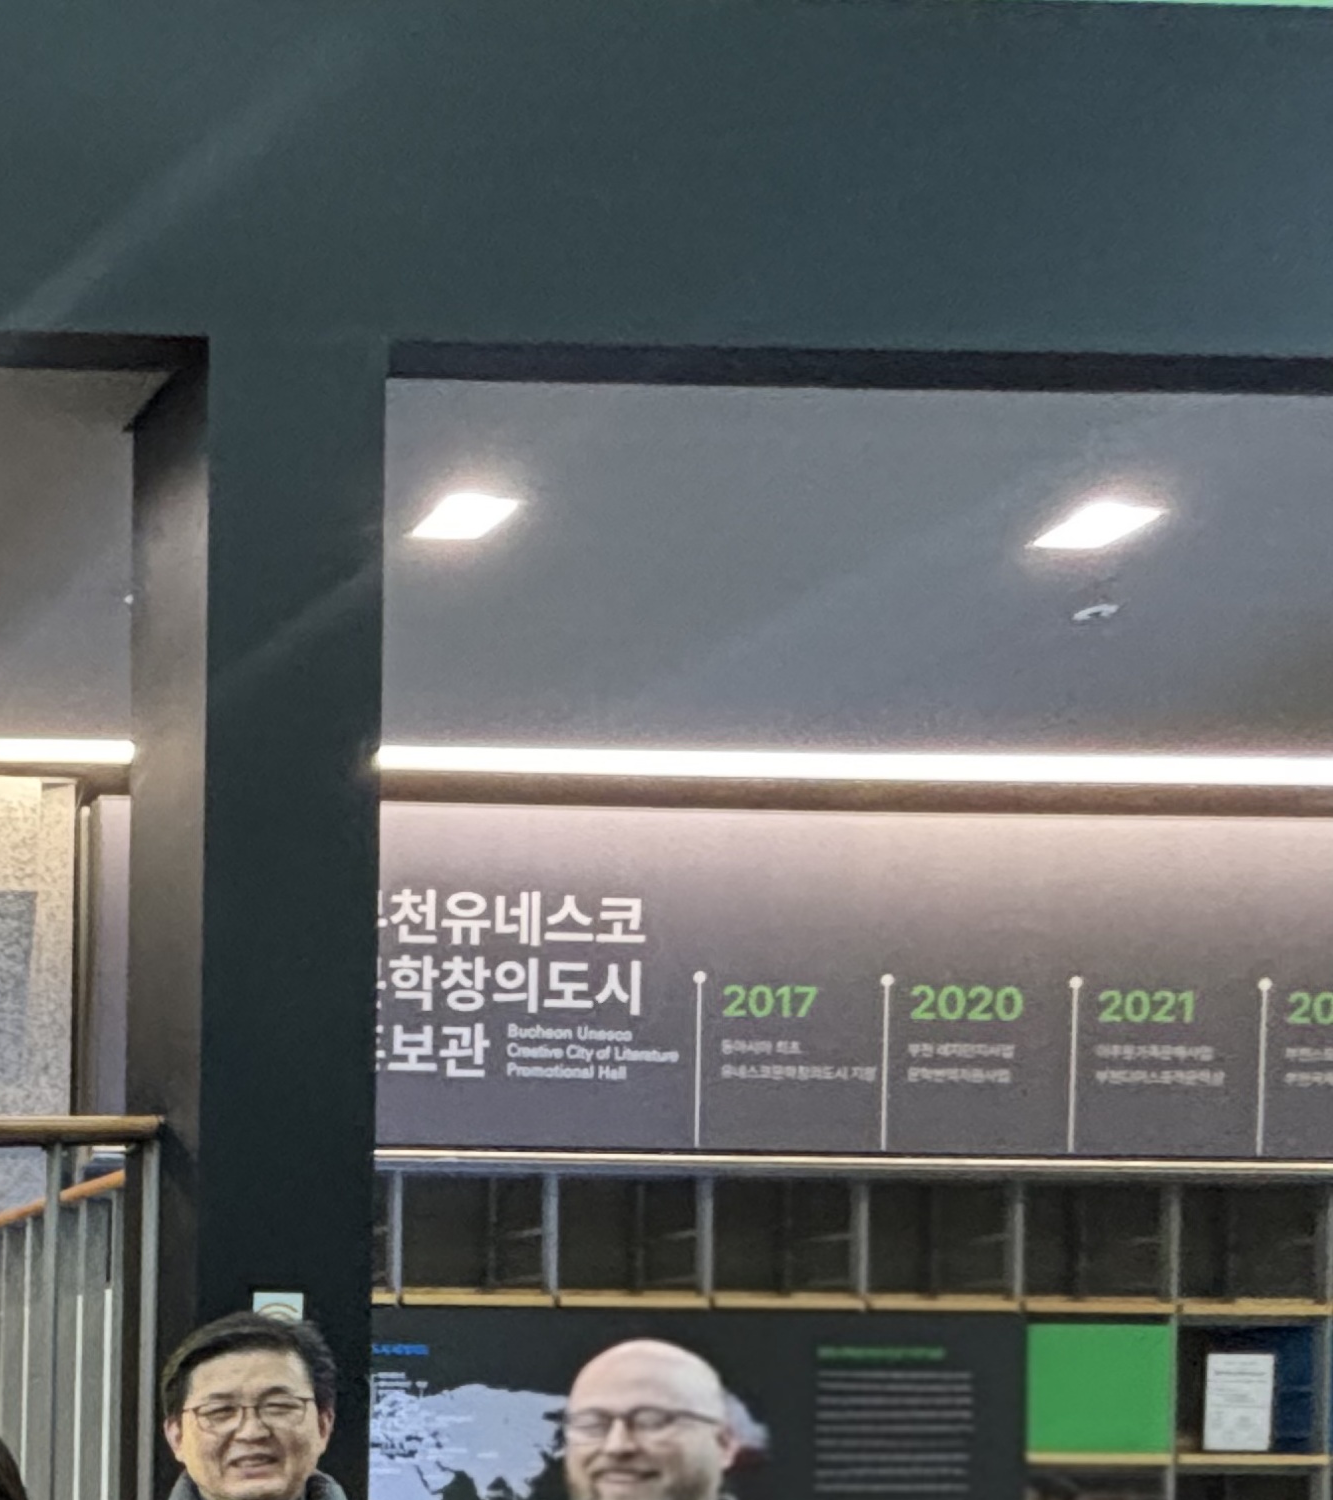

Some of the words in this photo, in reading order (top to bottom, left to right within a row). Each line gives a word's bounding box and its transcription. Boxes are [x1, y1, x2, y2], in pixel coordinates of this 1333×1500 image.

[377, 889, 646, 946] 천유네스코
[376, 954, 642, 1016] 학창의도시
[722, 985, 818, 1018] 2017
[910, 985, 1024, 1021] 2020
[1098, 990, 1195, 1023] 2021
[507, 1023, 573, 1040] Bucheon
[577, 1025, 633, 1042] Unesco
[376, 1023, 490, 1077] 보관
[507, 1042, 564, 1059] Creative
[566, 1044, 595, 1062] City
[596, 1046, 611, 1061] of
[613, 1046, 680, 1063] Literature
[507, 1062, 595, 1079] Promotional
[597, 1065, 628, 1080] Hall
